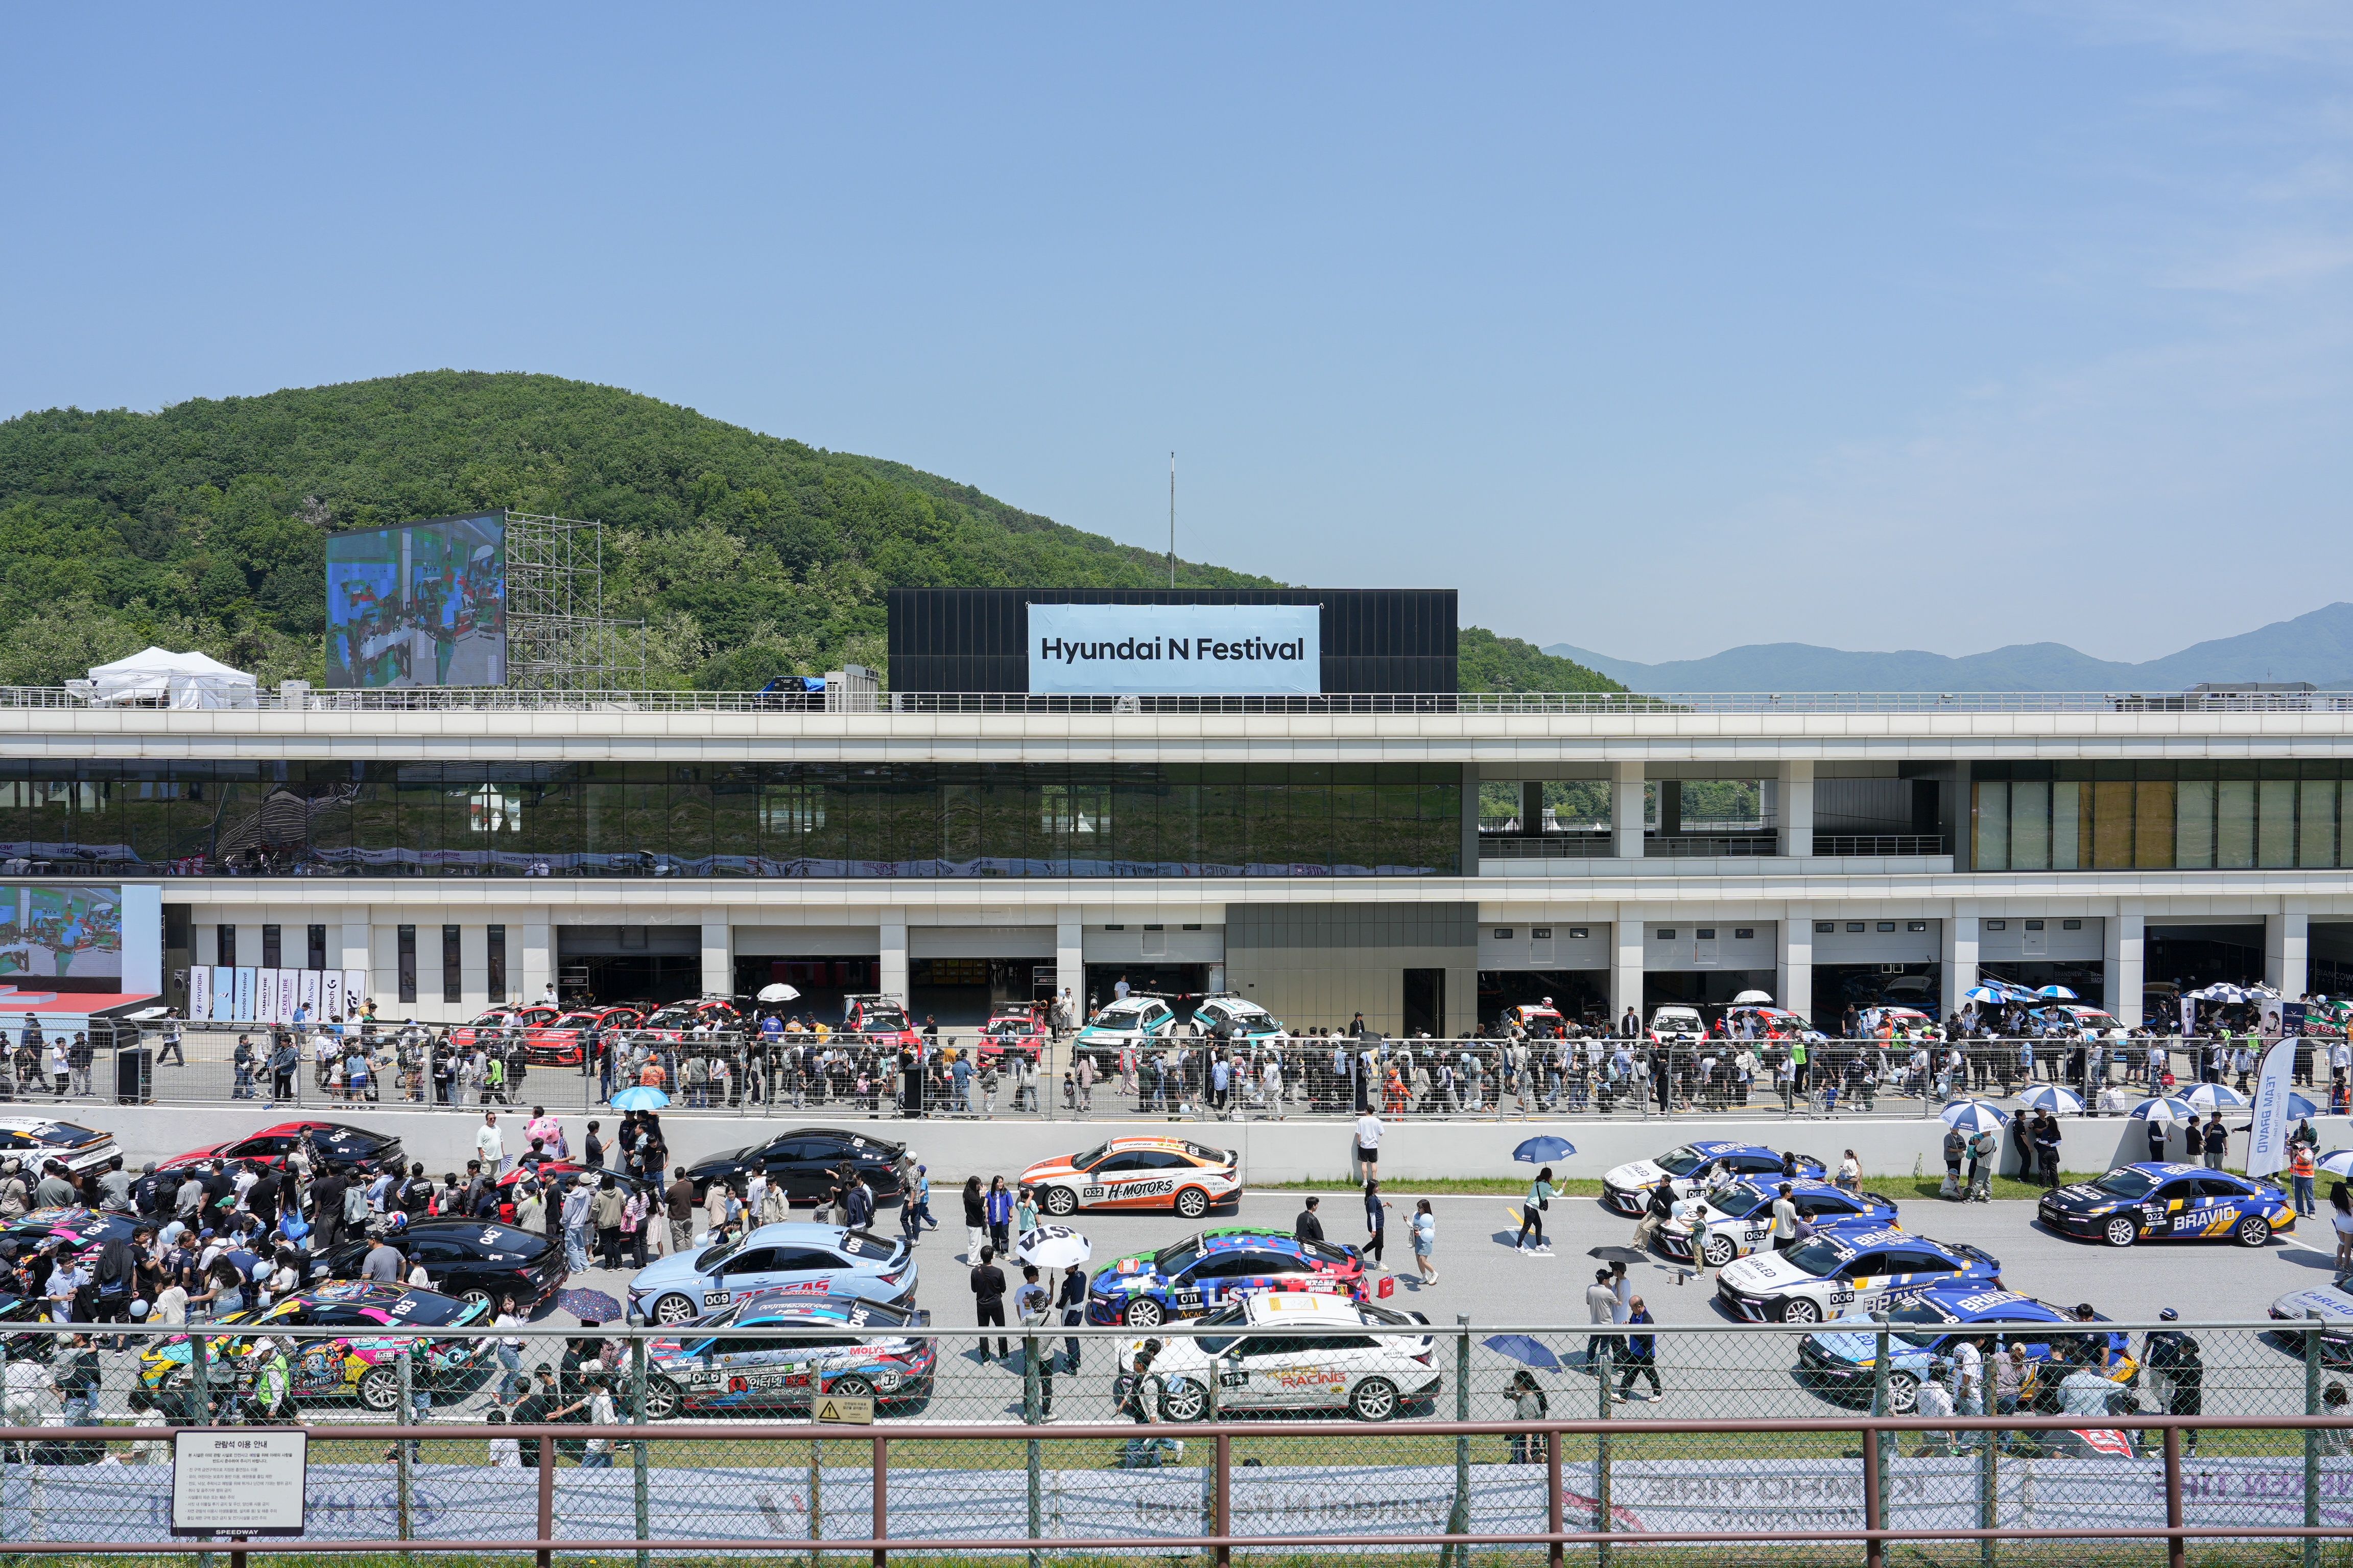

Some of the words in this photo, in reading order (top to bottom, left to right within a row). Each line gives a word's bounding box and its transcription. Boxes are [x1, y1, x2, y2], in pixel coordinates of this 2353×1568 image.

[1041, 636, 1160, 664] Hyundai
[1169, 638, 1189, 660] N
[1197, 636, 1303, 660] Festival
[328, 991, 337, 1018] logitech
[2320, 1026, 2333, 1034] 02
[32, 1125, 55, 1137] 160
[328, 1130, 352, 1143] 094
[412, 1181, 431, 1190] WEEKLY
[1084, 1188, 1103, 1196] 032
[1107, 1179, 1174, 1201] H-MOTORS
[1688, 1190, 1706, 1198] 066
[2066, 1185, 2102, 1200] CARLED
[2188, 1205, 2205, 1214] PREMIUM
[2213, 1201, 2232, 1209] HEADLAMP
[2146, 1212, 2164, 1222] 022
[2174, 1205, 2236, 1231] BRAVIO
[82, 1222, 111, 1236] 194
[1746, 1231, 1765, 1240] 062
[479, 1229, 503, 1245] 042
[846, 1238, 863, 1253] 009
[1744, 1257, 1777, 1277] CARLED
[1912, 1281, 1936, 1289] HEADLAMP
[704, 1293, 729, 1305] 009
[1181, 1293, 1198, 1304] 011
[1831, 1292, 1853, 1303] 006
[391, 1299, 417, 1316] 193
[849, 1309, 870, 1328] 046
[849, 1346, 886, 1355] MOLYS
[692, 1371, 721, 1384] 046
[748, 1376, 783, 1389] 인터넷
[1281, 1371, 1347, 1388] RACING
